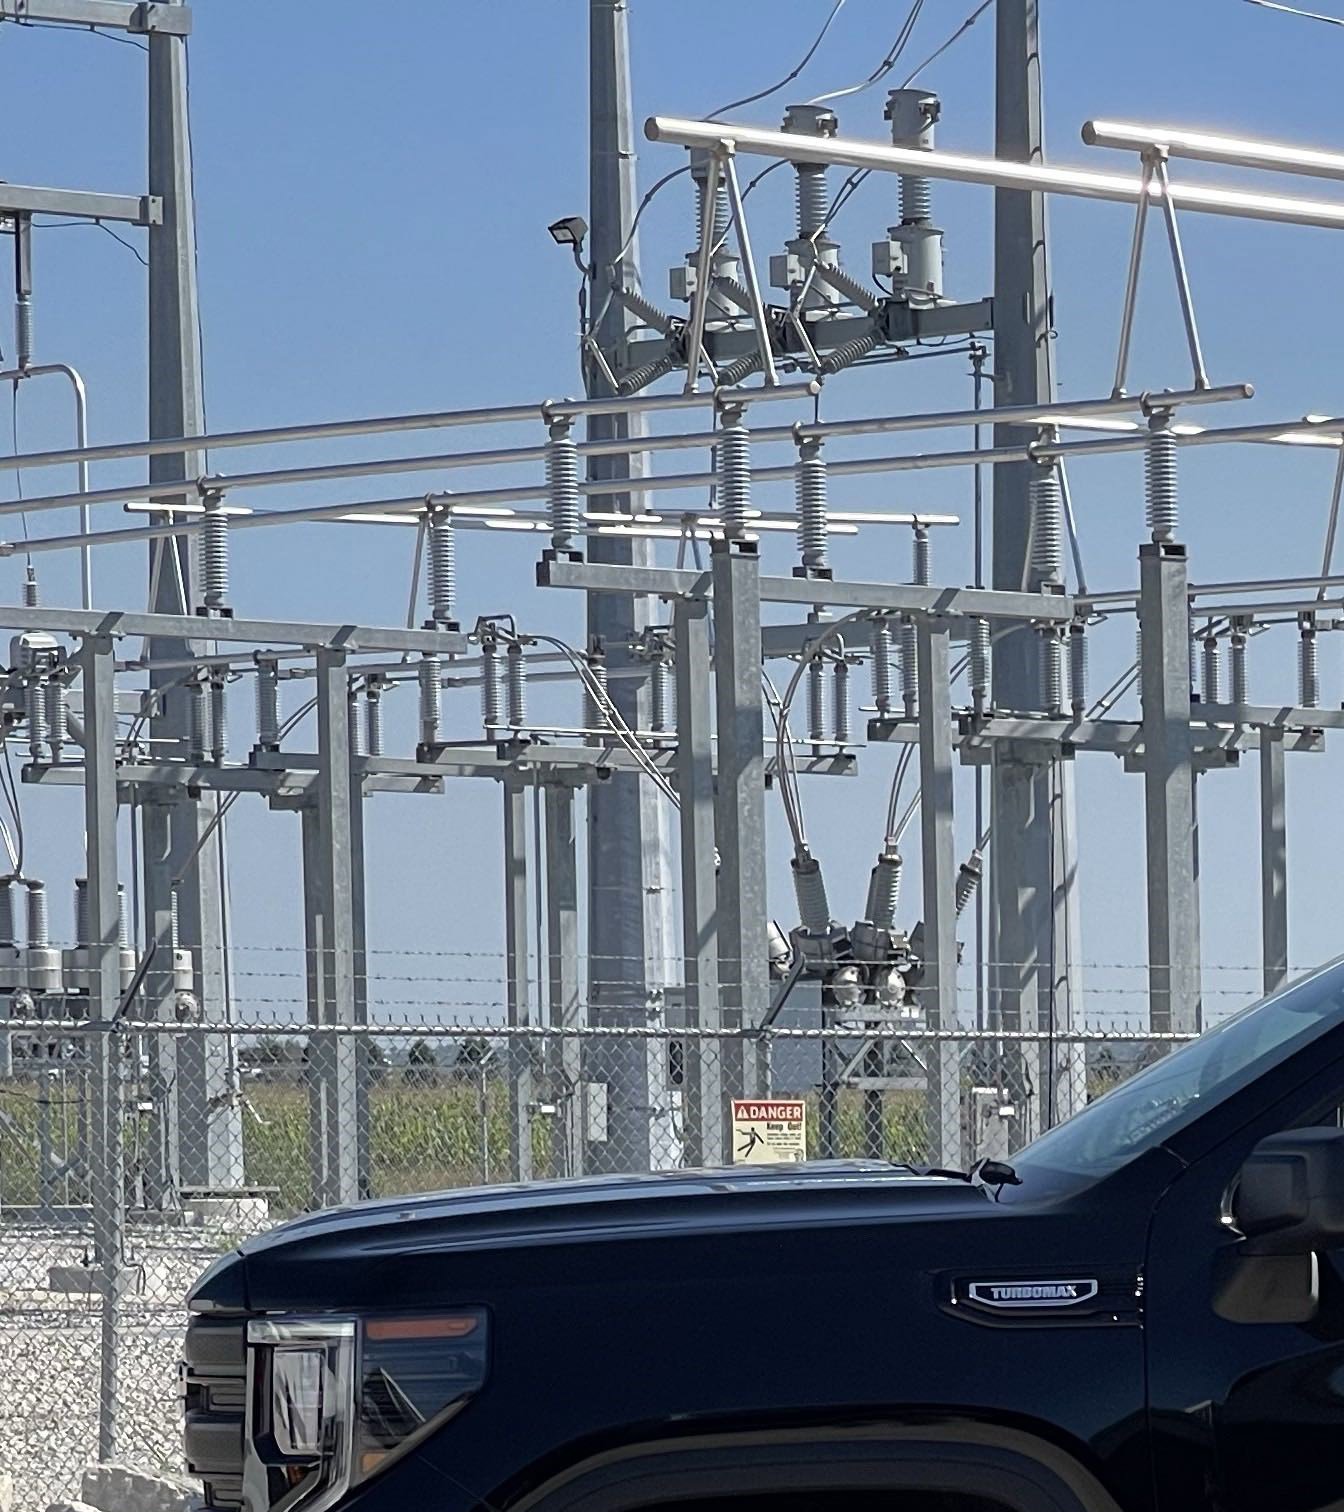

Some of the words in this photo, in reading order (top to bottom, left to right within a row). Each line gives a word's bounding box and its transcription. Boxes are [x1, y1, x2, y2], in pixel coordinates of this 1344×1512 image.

[750, 1106, 802, 1119] DANGER
[767, 1122, 784, 1132] Keep
[990, 1284, 1078, 1300] TURBOMAX
